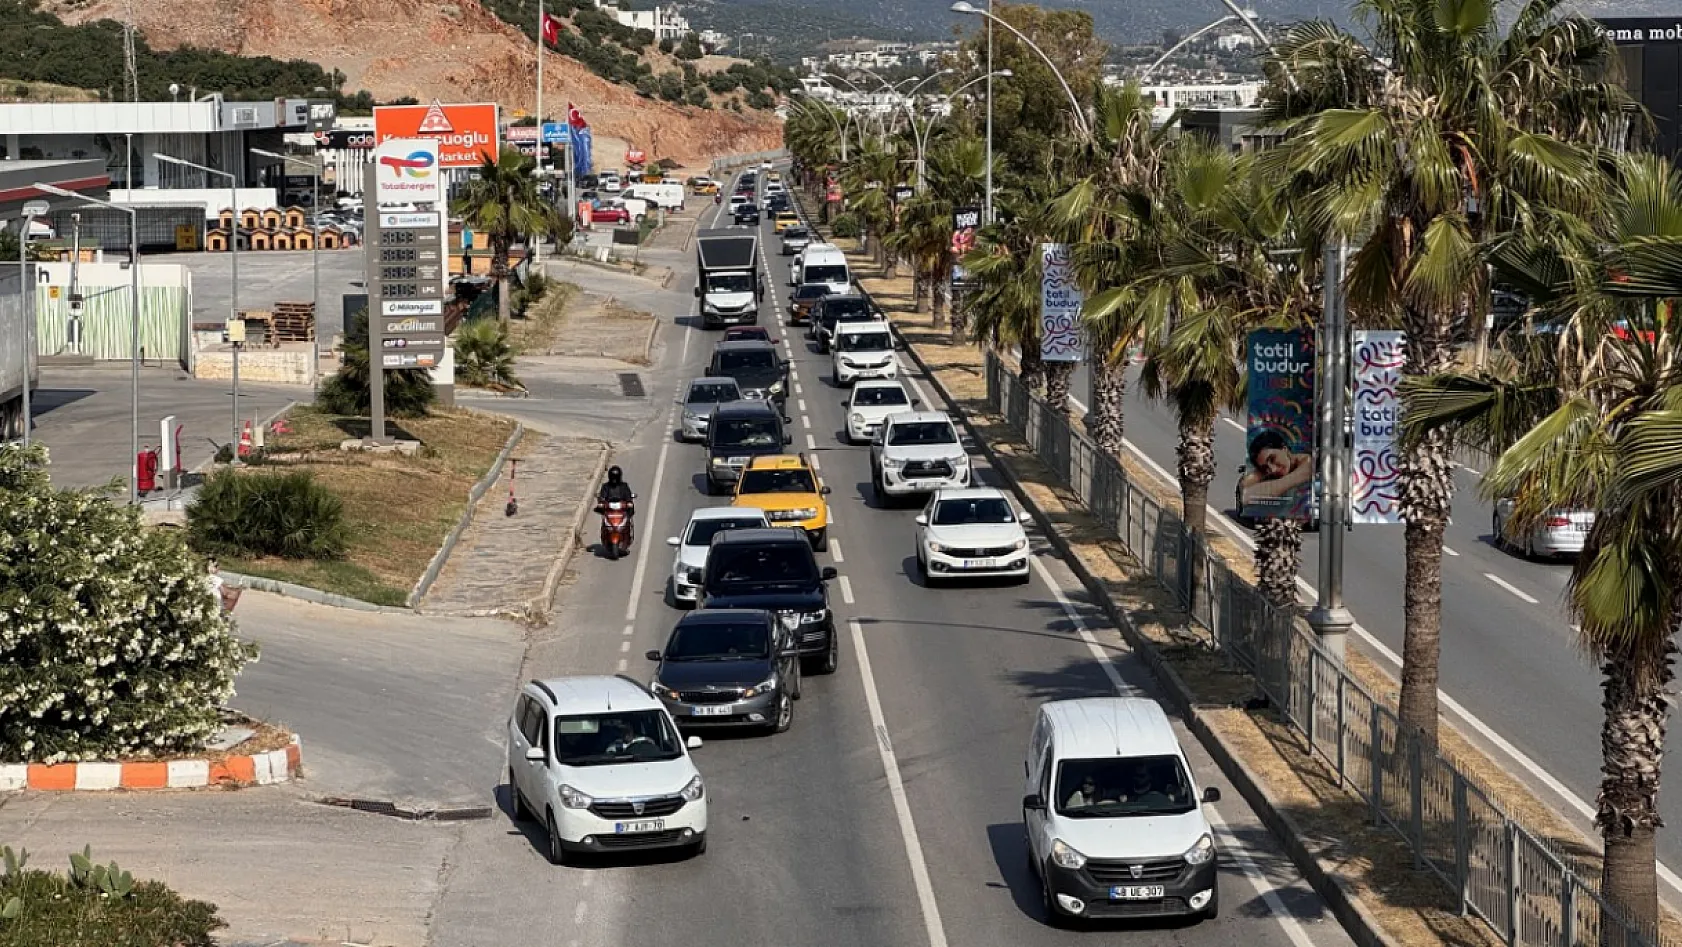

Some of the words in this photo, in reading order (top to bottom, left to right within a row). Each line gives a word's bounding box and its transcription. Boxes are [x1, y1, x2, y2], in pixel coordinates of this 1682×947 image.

[381, 182, 436, 191] TotalEnergies
[422, 286, 435, 294] LPG
[1254, 342, 1293, 357] tatil
[1254, 358, 1310, 373] budur
